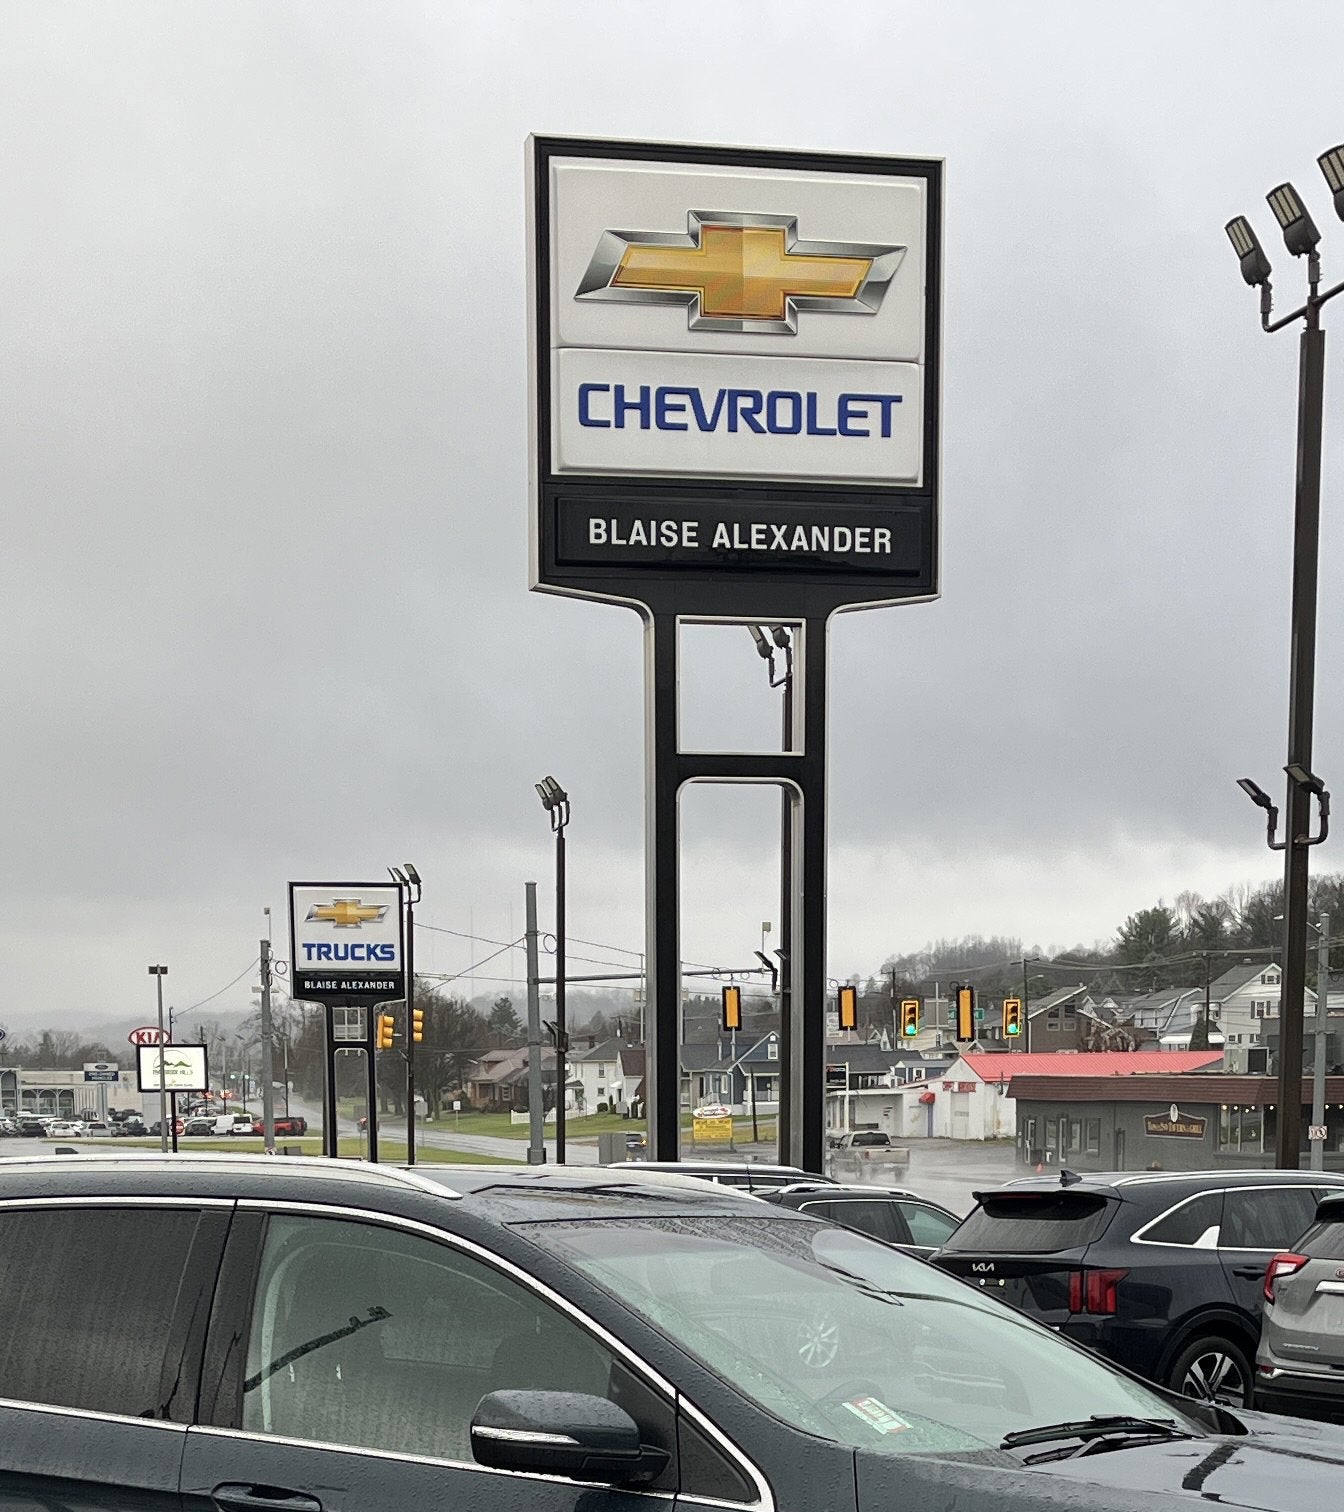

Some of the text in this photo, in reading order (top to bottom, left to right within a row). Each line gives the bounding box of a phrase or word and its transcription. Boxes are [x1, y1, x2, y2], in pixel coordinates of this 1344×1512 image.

[577, 383, 903, 438] CHEVROLET
[588, 518, 893, 554] BLAISE ALEXANDER
[302, 943, 395, 961] TRUCKS
[304, 980, 395, 990] BLAISE ALEXANDER
